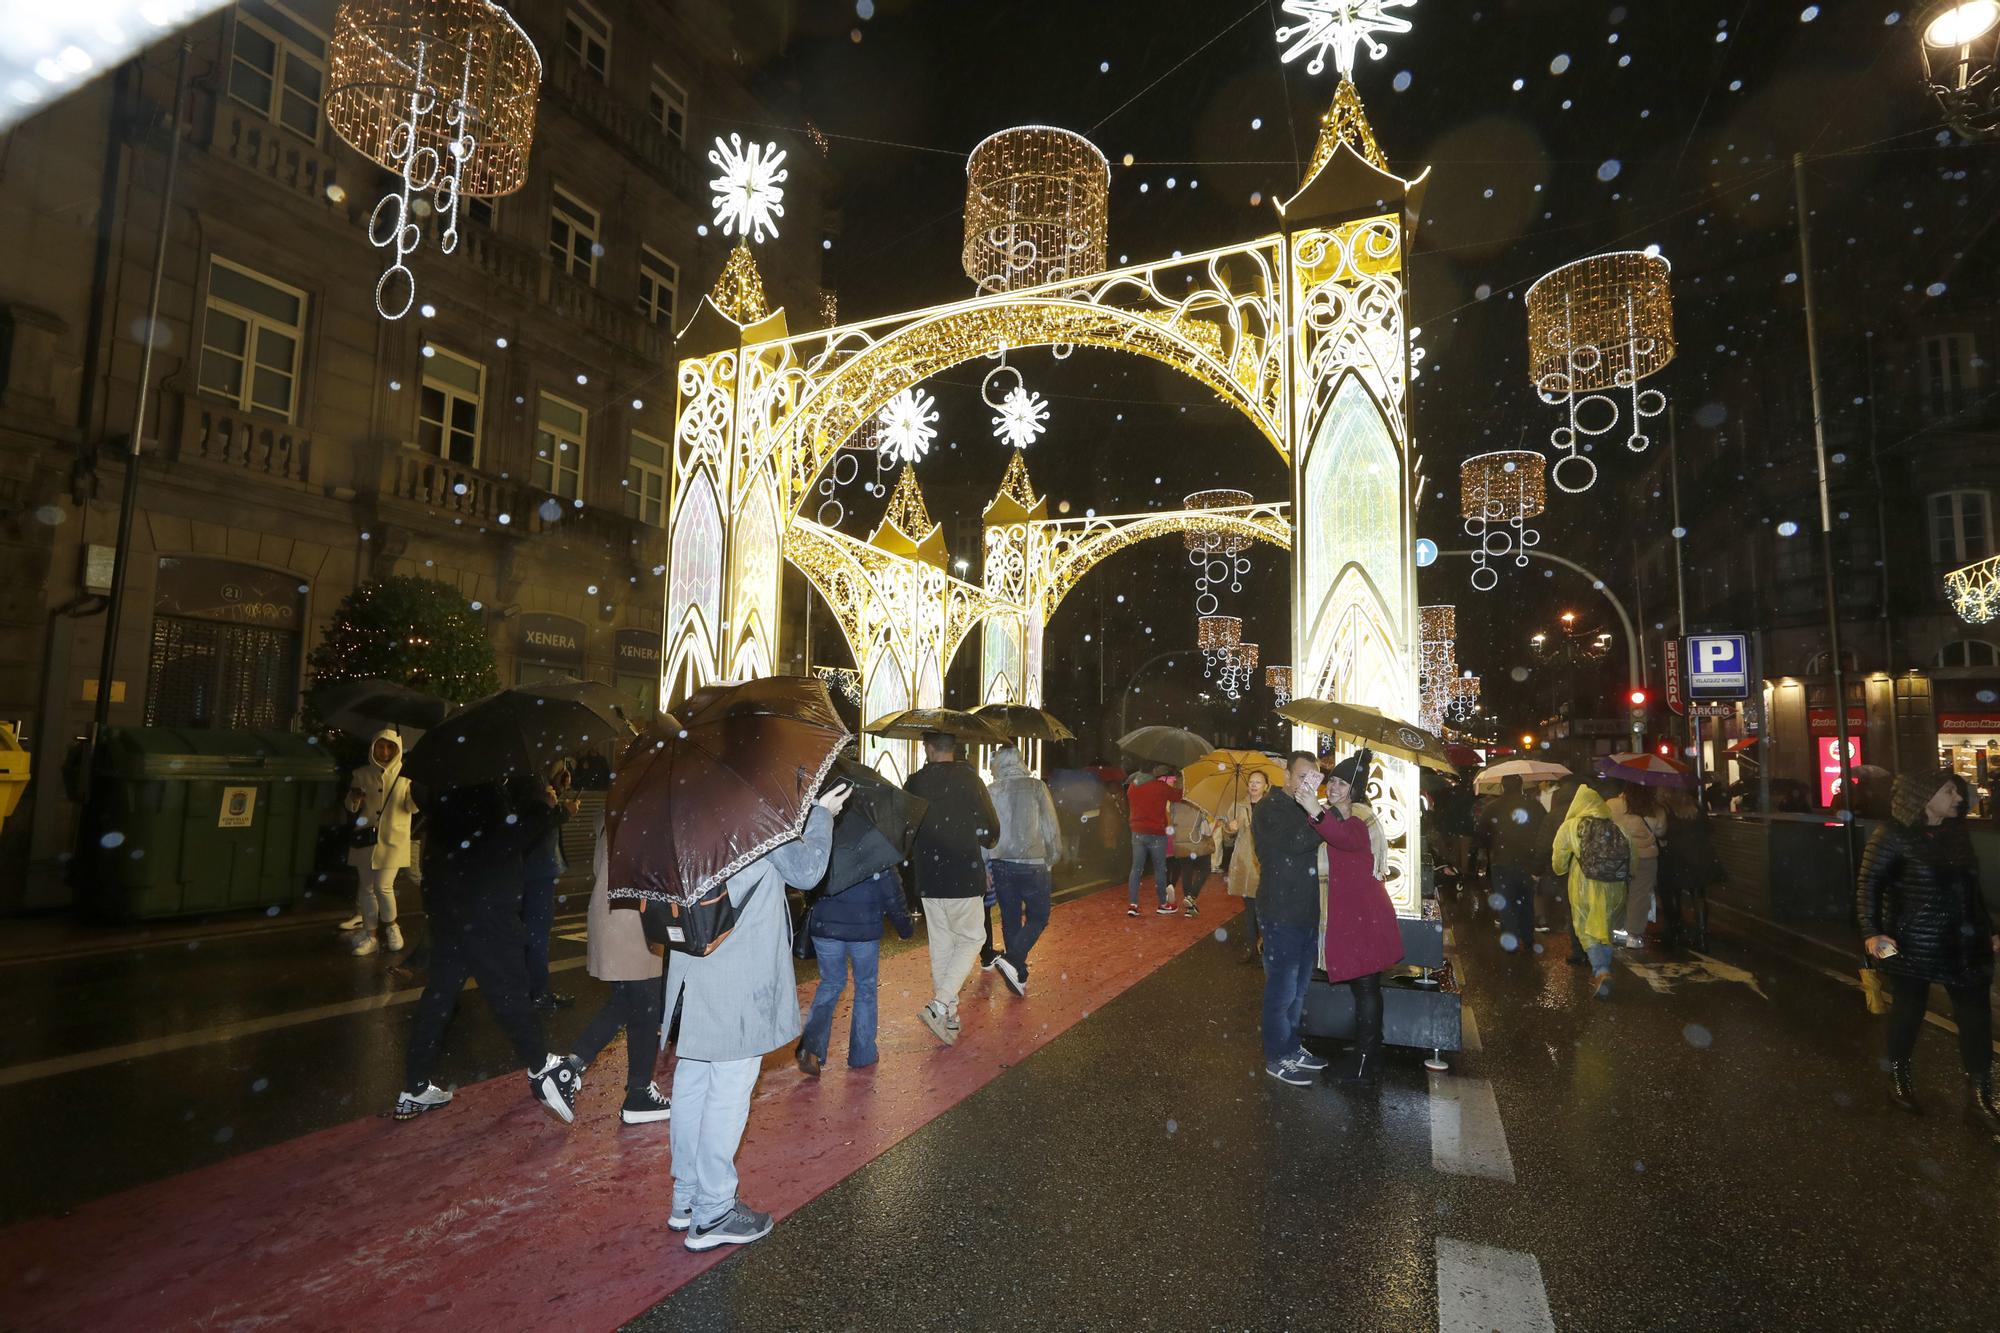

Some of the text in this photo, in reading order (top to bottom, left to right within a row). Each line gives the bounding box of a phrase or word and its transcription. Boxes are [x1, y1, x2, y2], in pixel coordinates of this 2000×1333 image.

[526, 630, 575, 649] XENERA
[620, 644, 660, 660] XENERA
[1699, 640, 1734, 673] P
[1667, 642, 1678, 703] ENTRADA
[1847, 718, 1862, 726] ars
[1943, 719, 1965, 729] Foot
